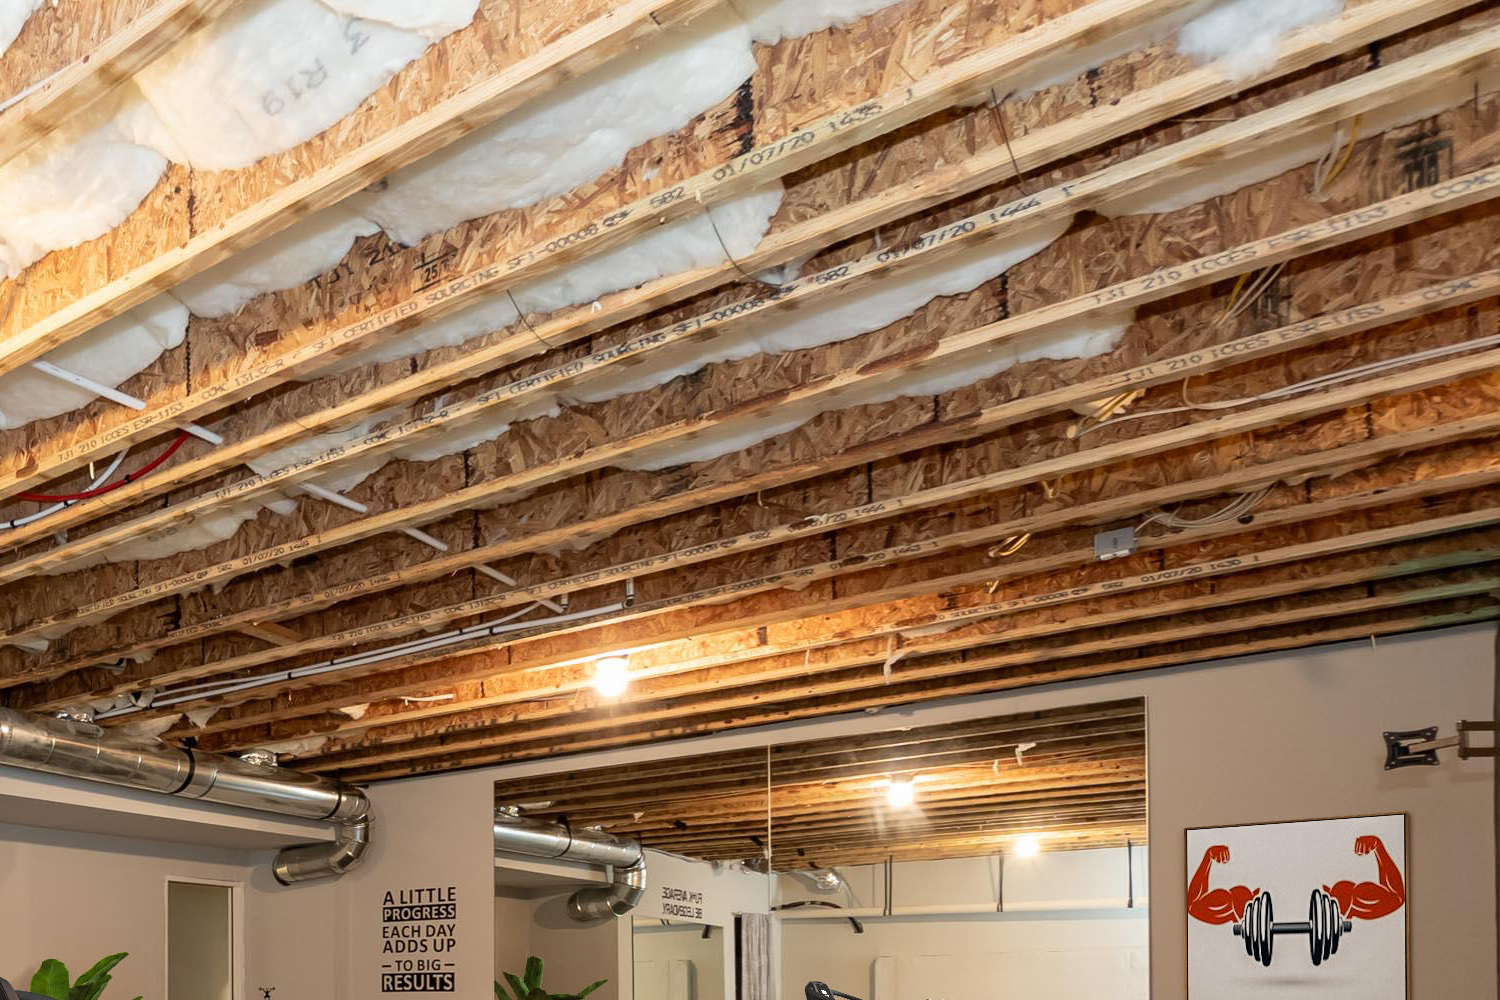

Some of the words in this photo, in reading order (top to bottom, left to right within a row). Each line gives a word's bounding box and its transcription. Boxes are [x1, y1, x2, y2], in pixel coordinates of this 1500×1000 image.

[343, 301, 419, 339] CERTIFIED
[424, 266, 500, 304] SOURCING
[712, 130, 816, 182] 01/07/20
[509, 360, 585, 396] CERTIFIED
[383, 891, 395, 906] A
[400, 887, 457, 904] LITTLE
[383, 905, 456, 921] PROGRESS
[382, 925, 421, 939] EACH
[426, 924, 456, 938] DAY
[383, 939, 428, 954] ADDS
[433, 938, 456, 952] UP
[395, 960, 413, 972] TO
[417, 959, 441, 971] BIG
[383, 974, 453, 991] RESULTS
